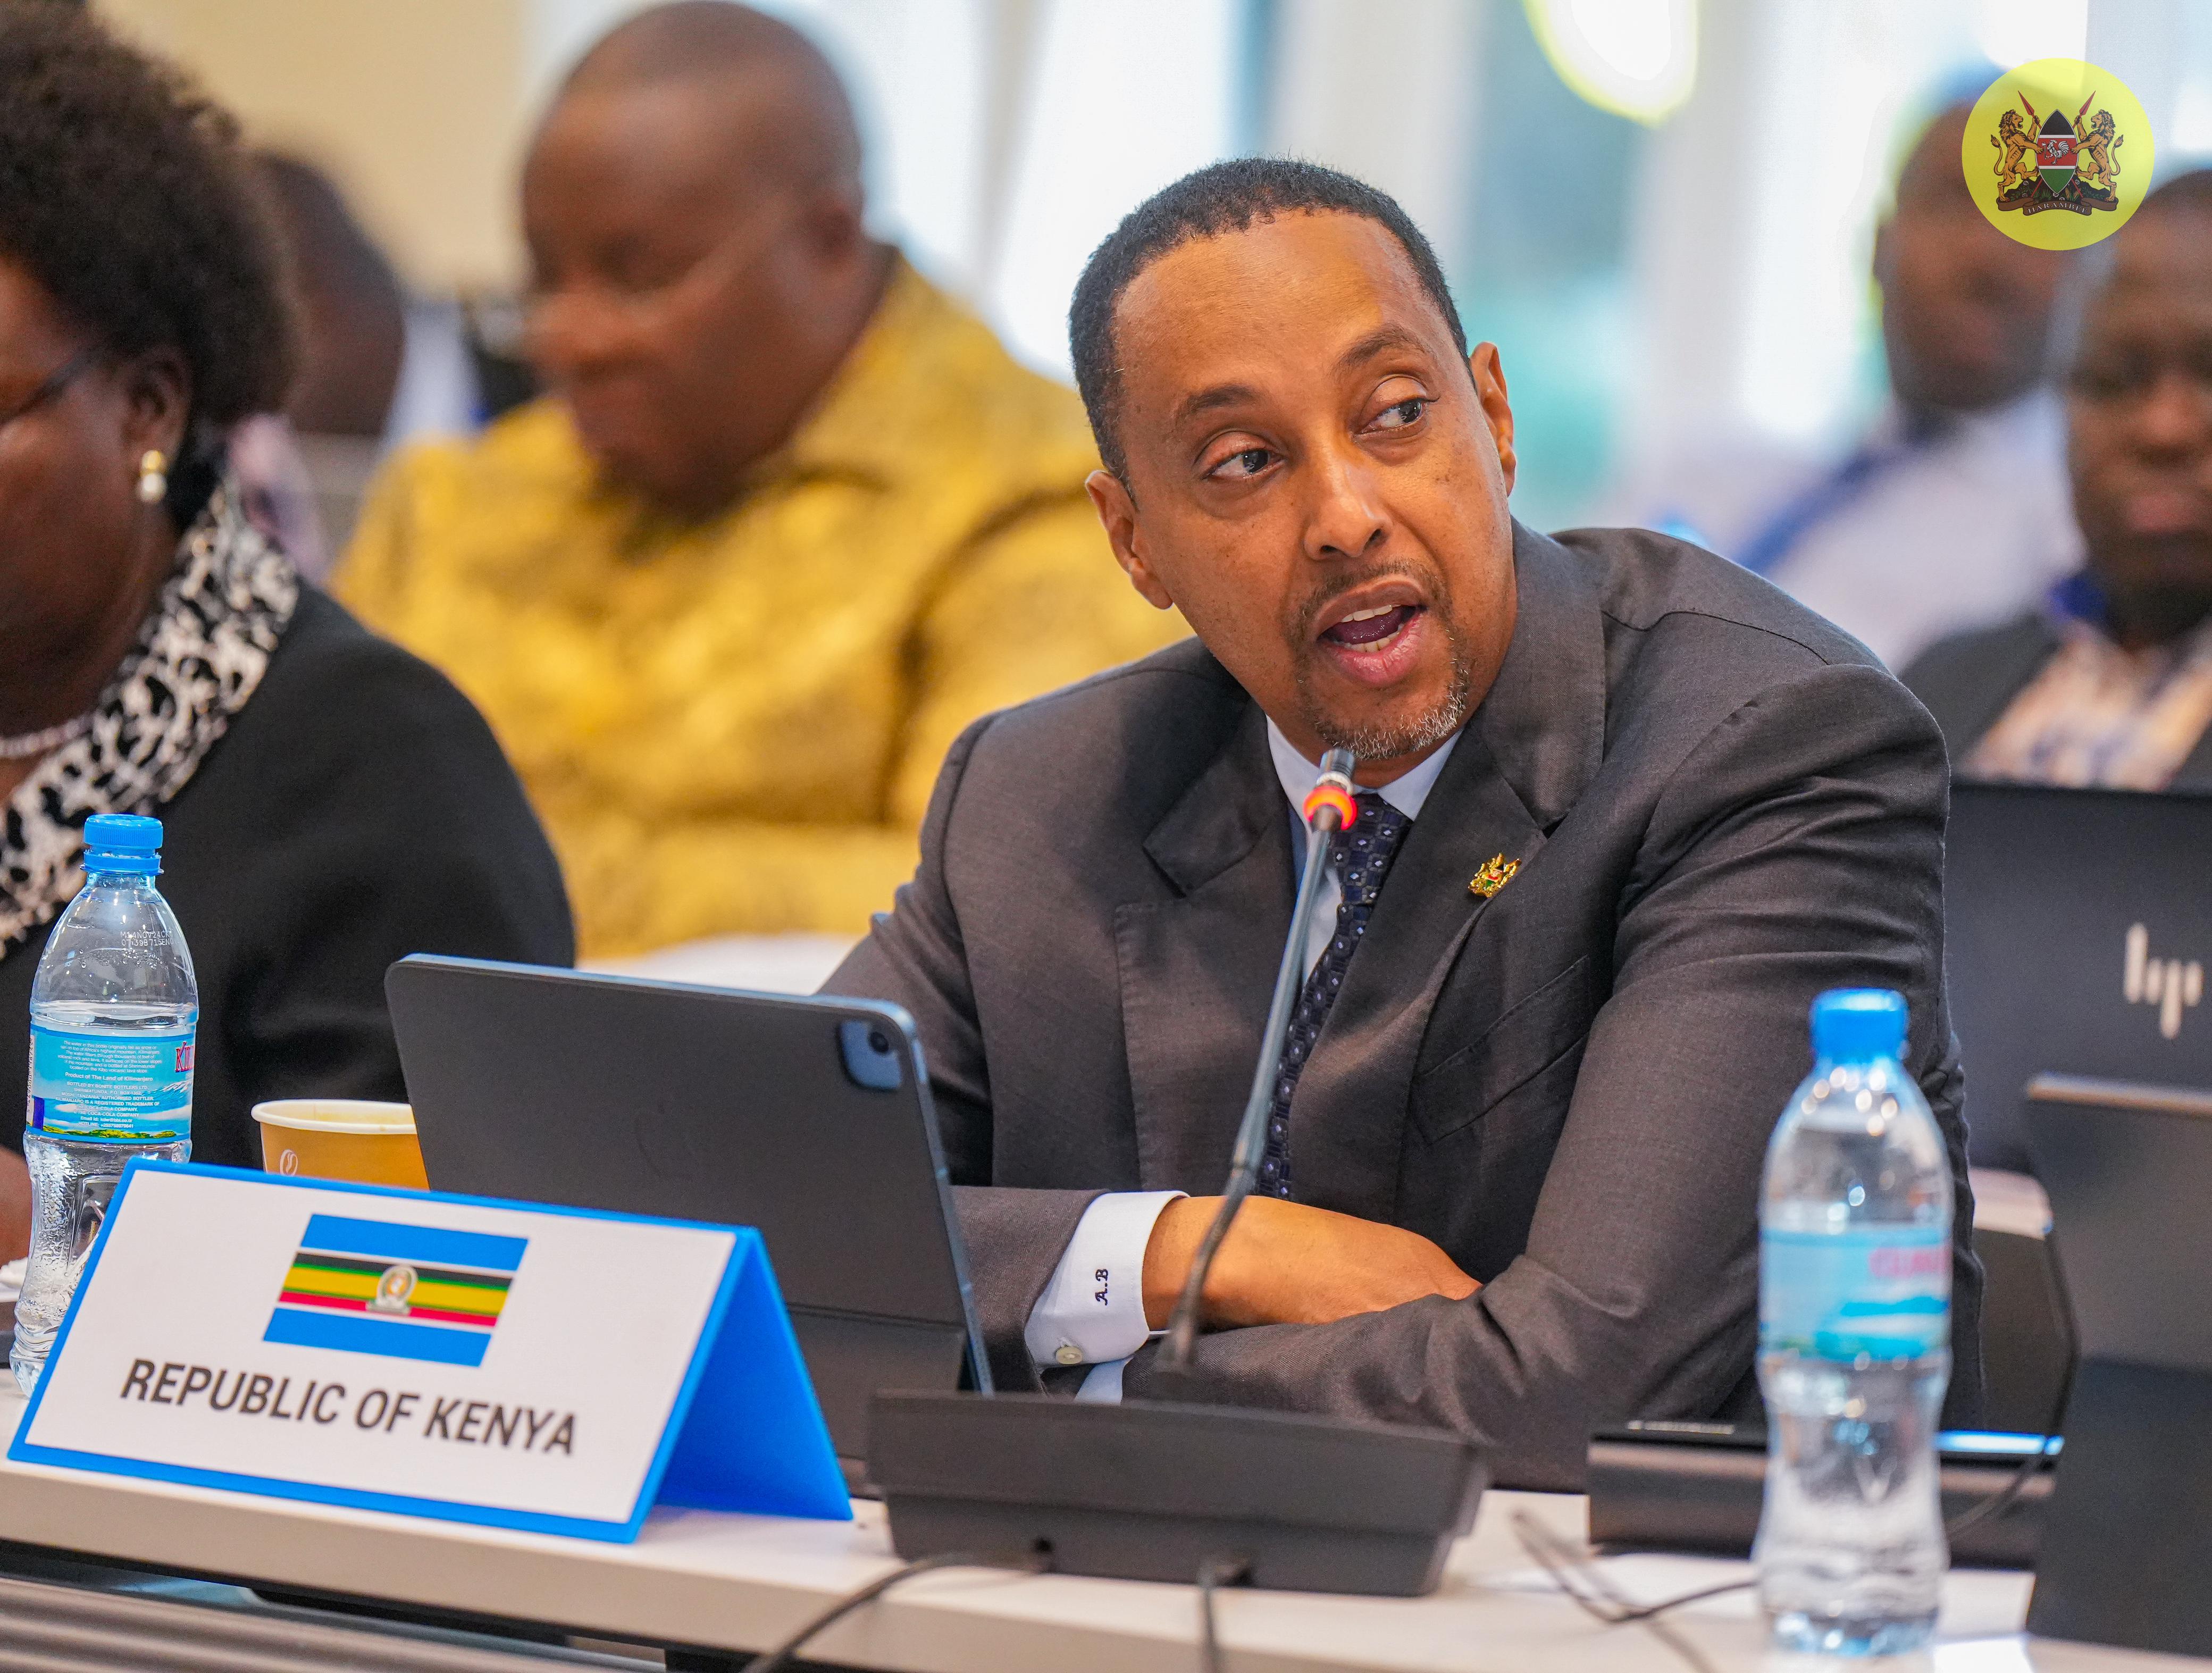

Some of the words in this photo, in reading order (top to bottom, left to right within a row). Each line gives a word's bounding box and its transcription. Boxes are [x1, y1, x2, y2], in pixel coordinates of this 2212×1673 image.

[1095, 1269, 1109, 1306] A.B
[120, 1359, 347, 1425] REPUBLIC
[355, 1390, 421, 1434] OF
[424, 1396, 577, 1457] KENYA
